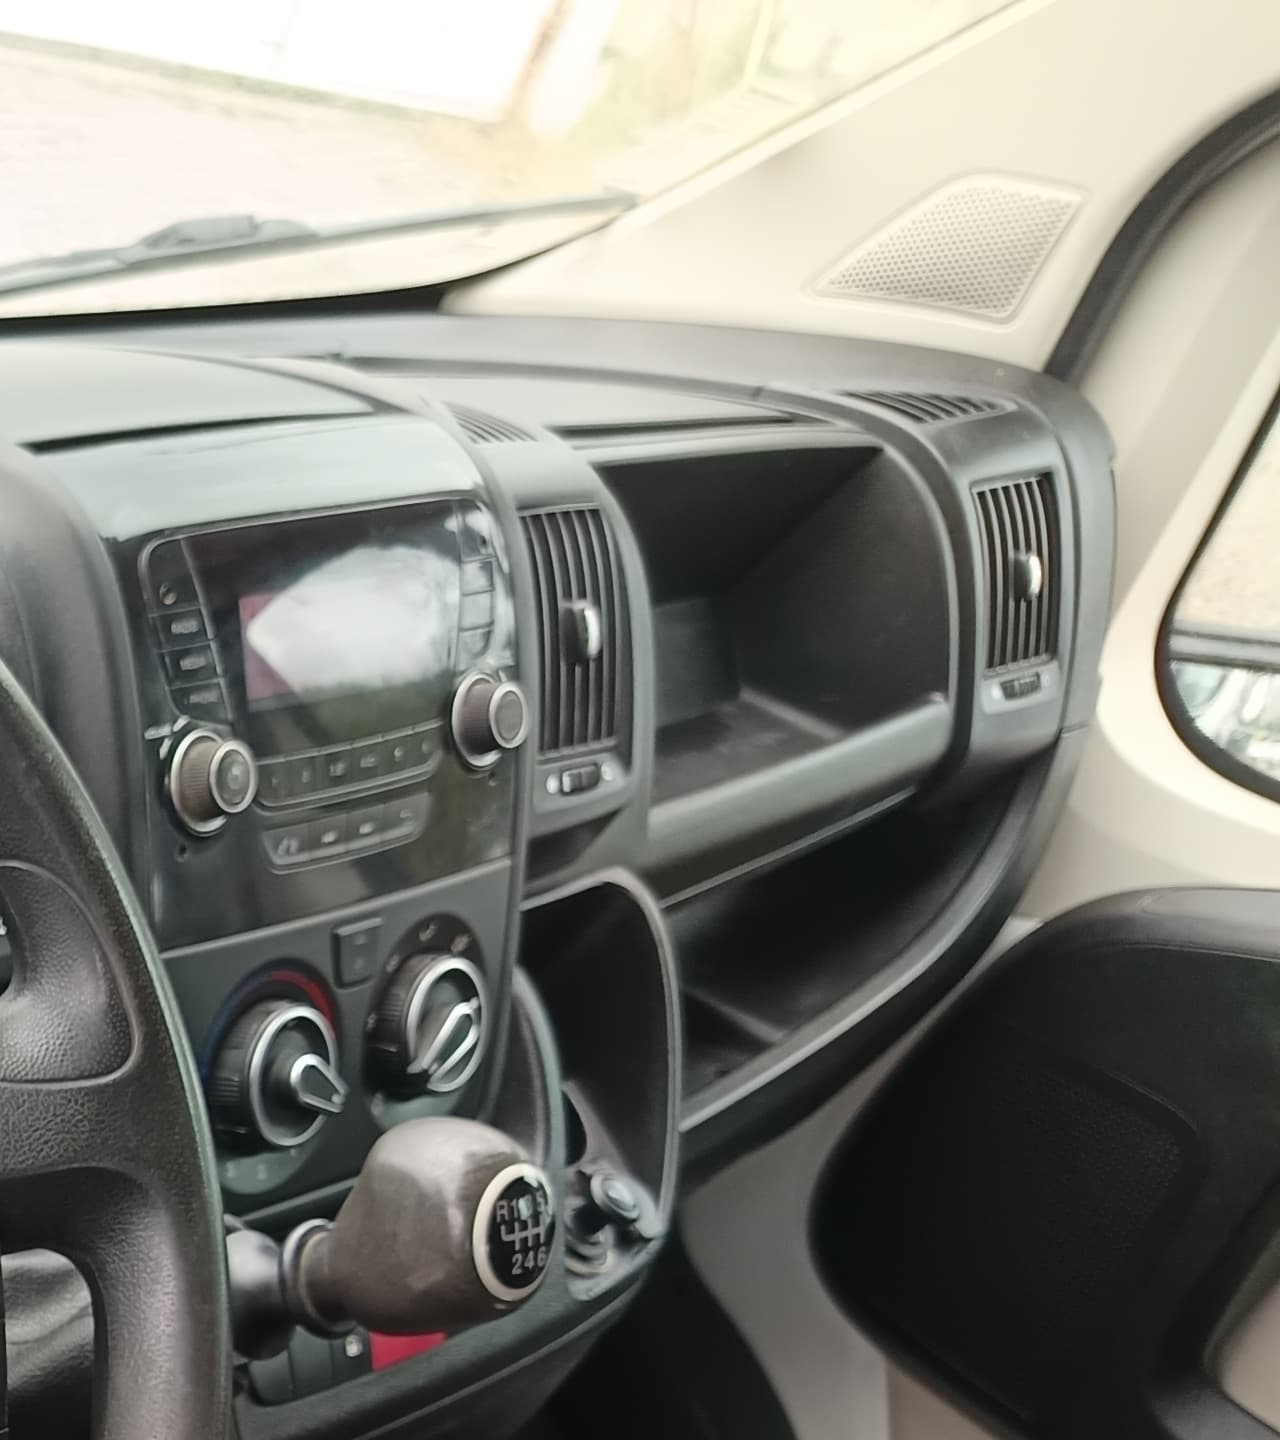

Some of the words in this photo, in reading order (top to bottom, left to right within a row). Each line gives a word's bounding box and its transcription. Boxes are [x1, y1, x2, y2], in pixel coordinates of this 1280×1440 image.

[496, 1199, 509, 1223] R
[510, 1198, 518, 1218] 1
[511, 1253, 522, 1275] 2
[524, 1250, 534, 1270] 4
[537, 1245, 547, 1268] 6
